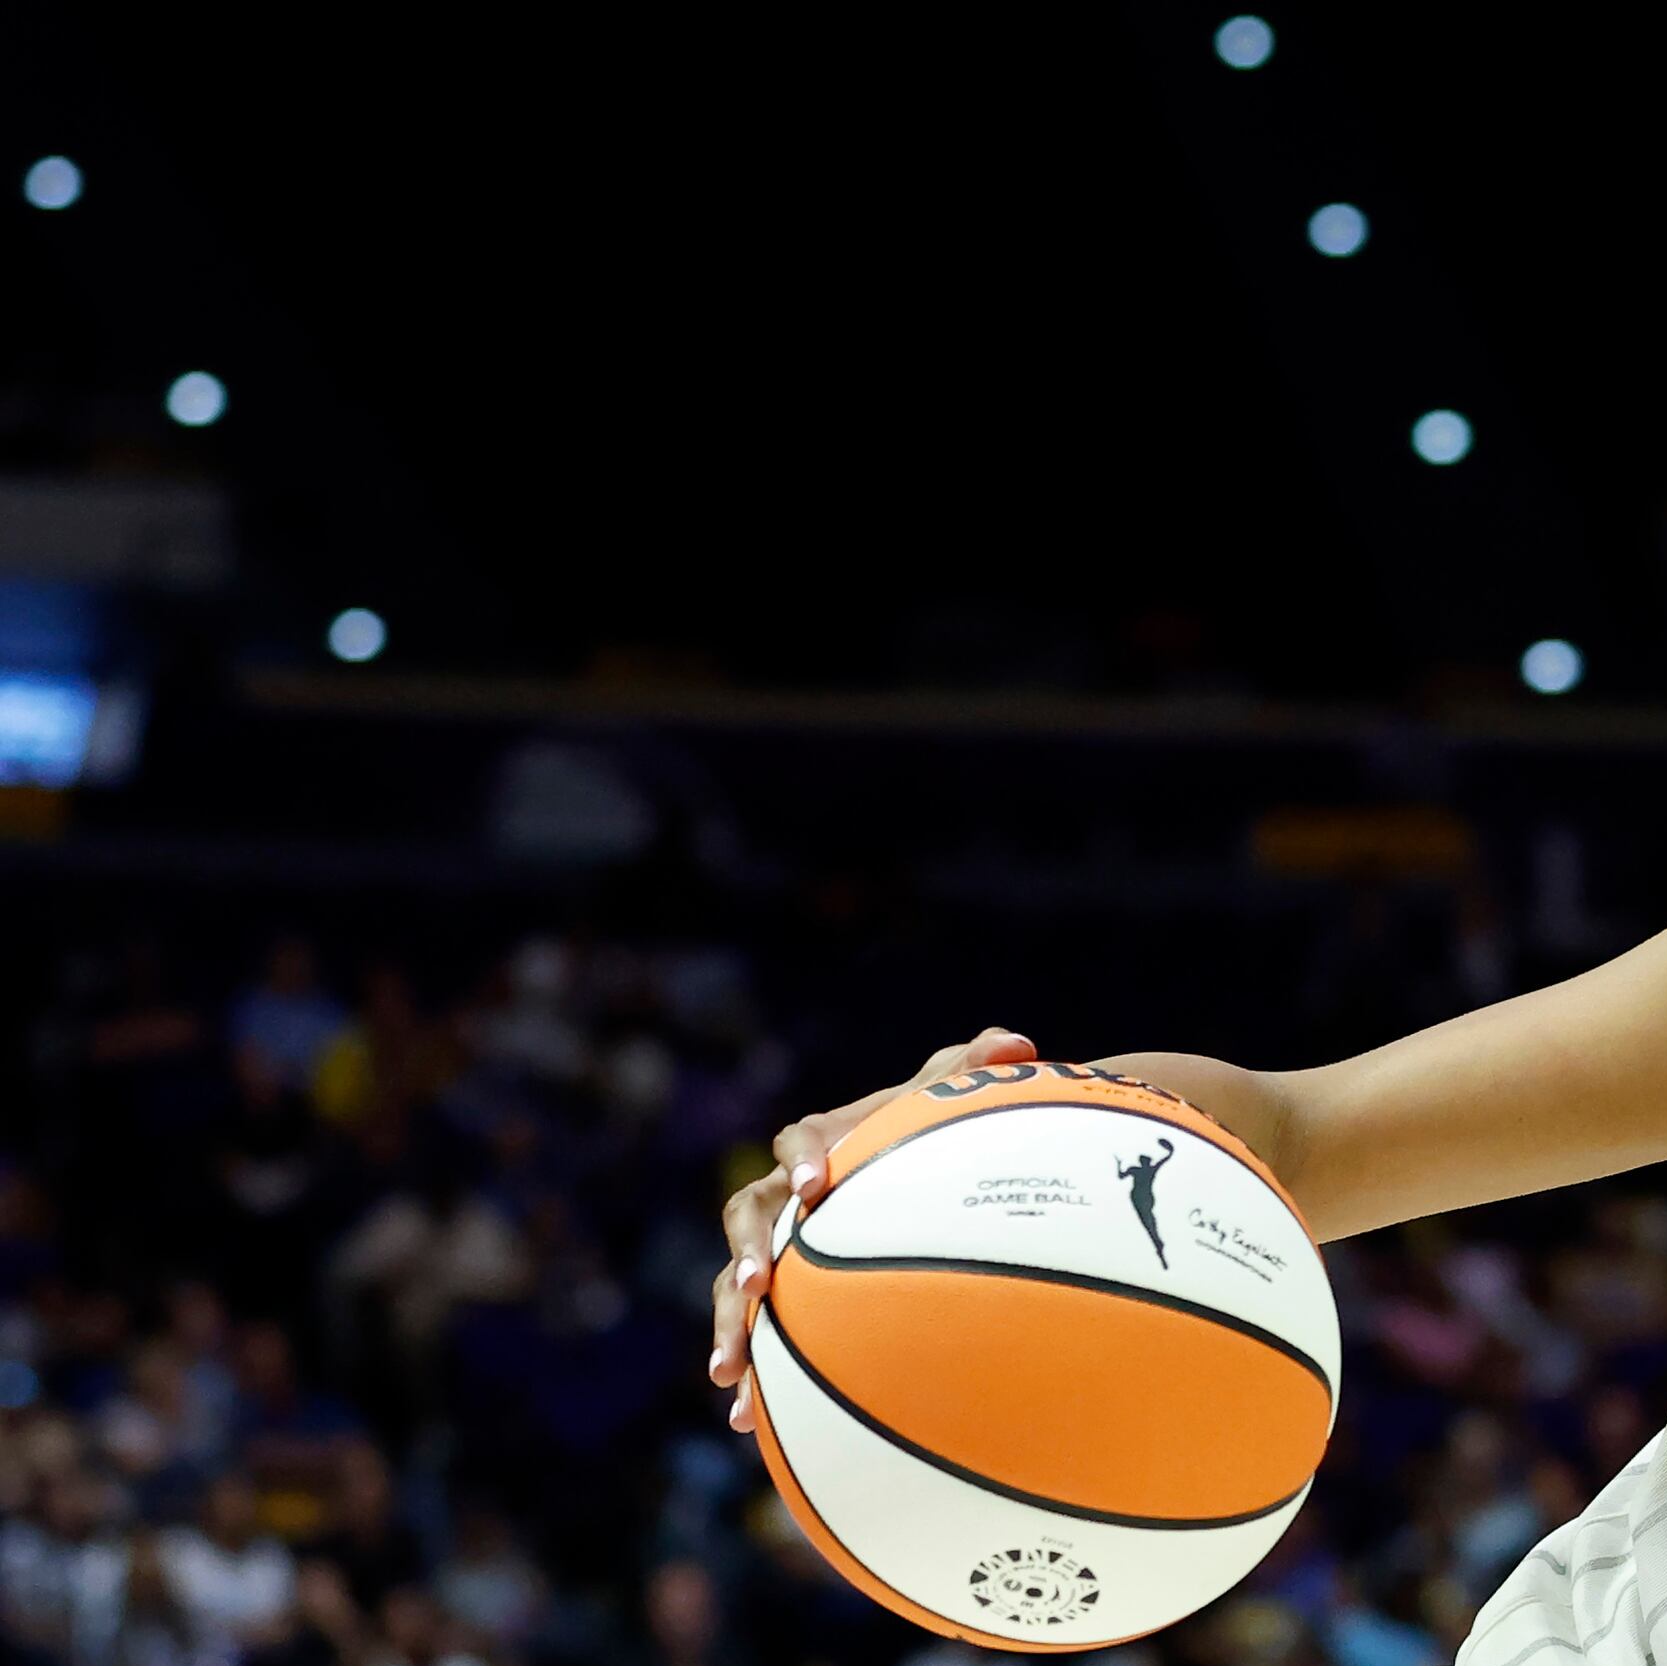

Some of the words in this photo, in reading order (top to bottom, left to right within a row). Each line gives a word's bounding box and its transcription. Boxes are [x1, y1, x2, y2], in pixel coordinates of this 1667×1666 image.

[978, 1177, 1076, 1190] OFFICIAL
[963, 1193, 1028, 1207] GAME
[1034, 1193, 1092, 1206] BALL
